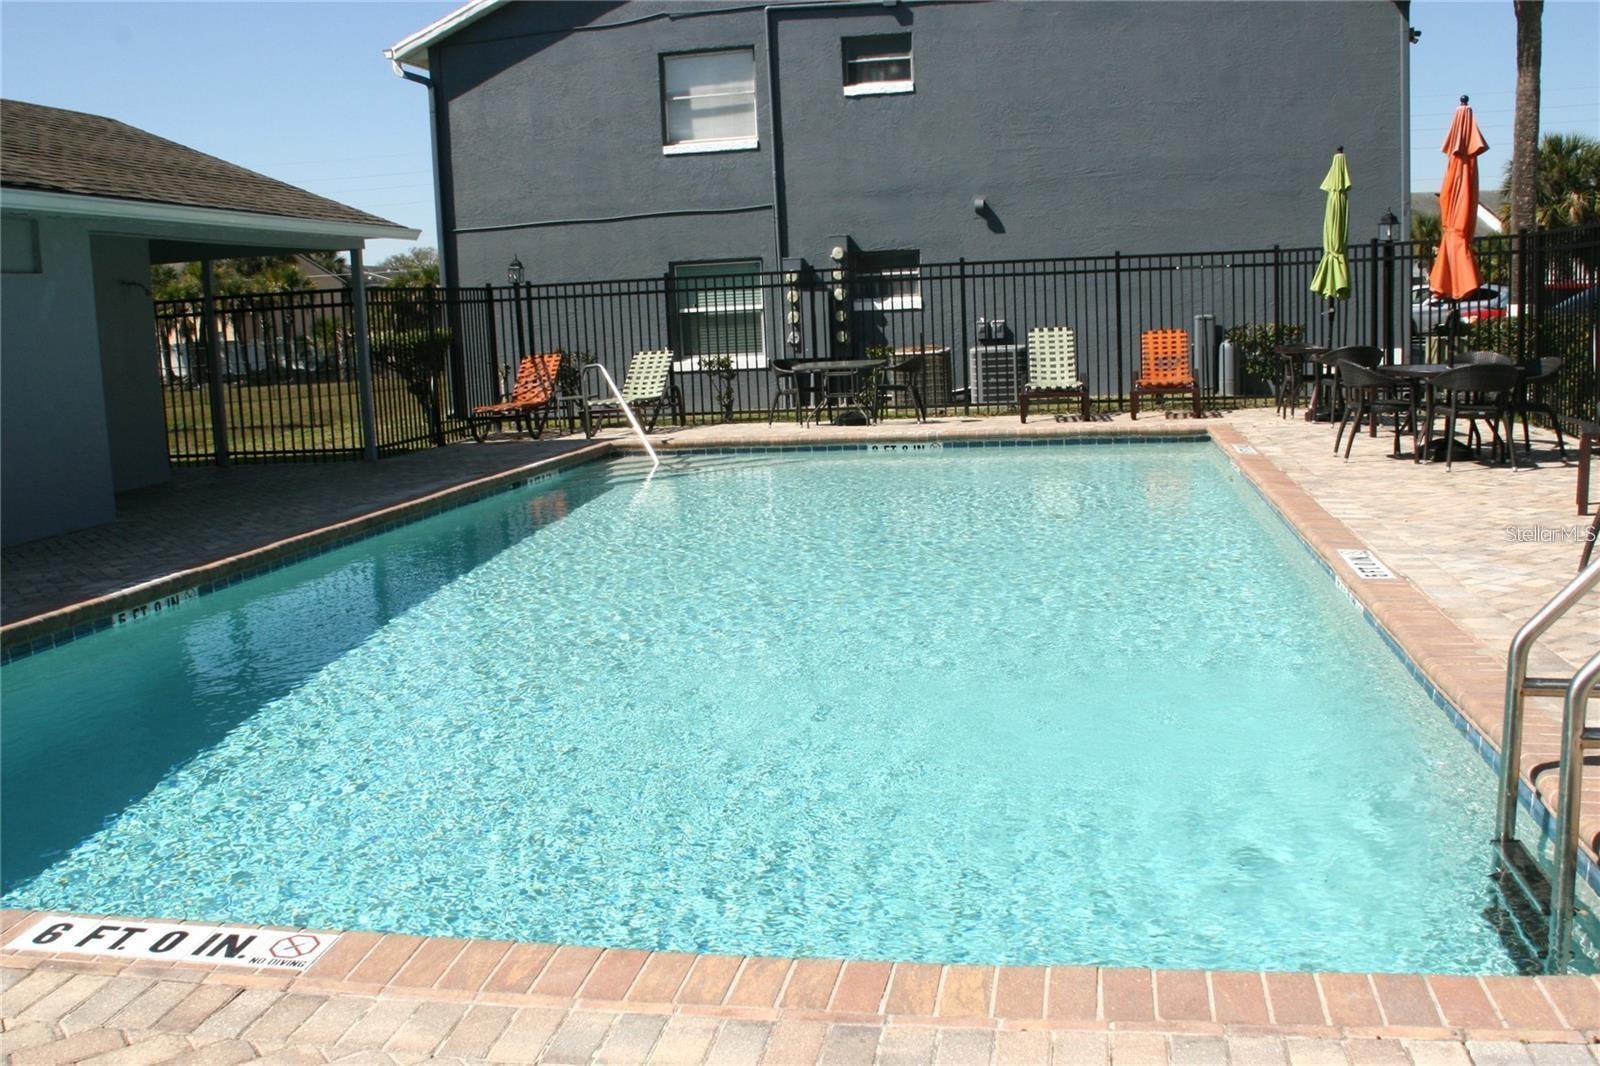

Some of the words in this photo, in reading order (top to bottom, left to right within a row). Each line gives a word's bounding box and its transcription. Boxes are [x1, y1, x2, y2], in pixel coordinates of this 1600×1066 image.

[32, 923, 73, 945] 6
[148, 931, 190, 953] 0
[267, 958, 307, 968] DIVING
